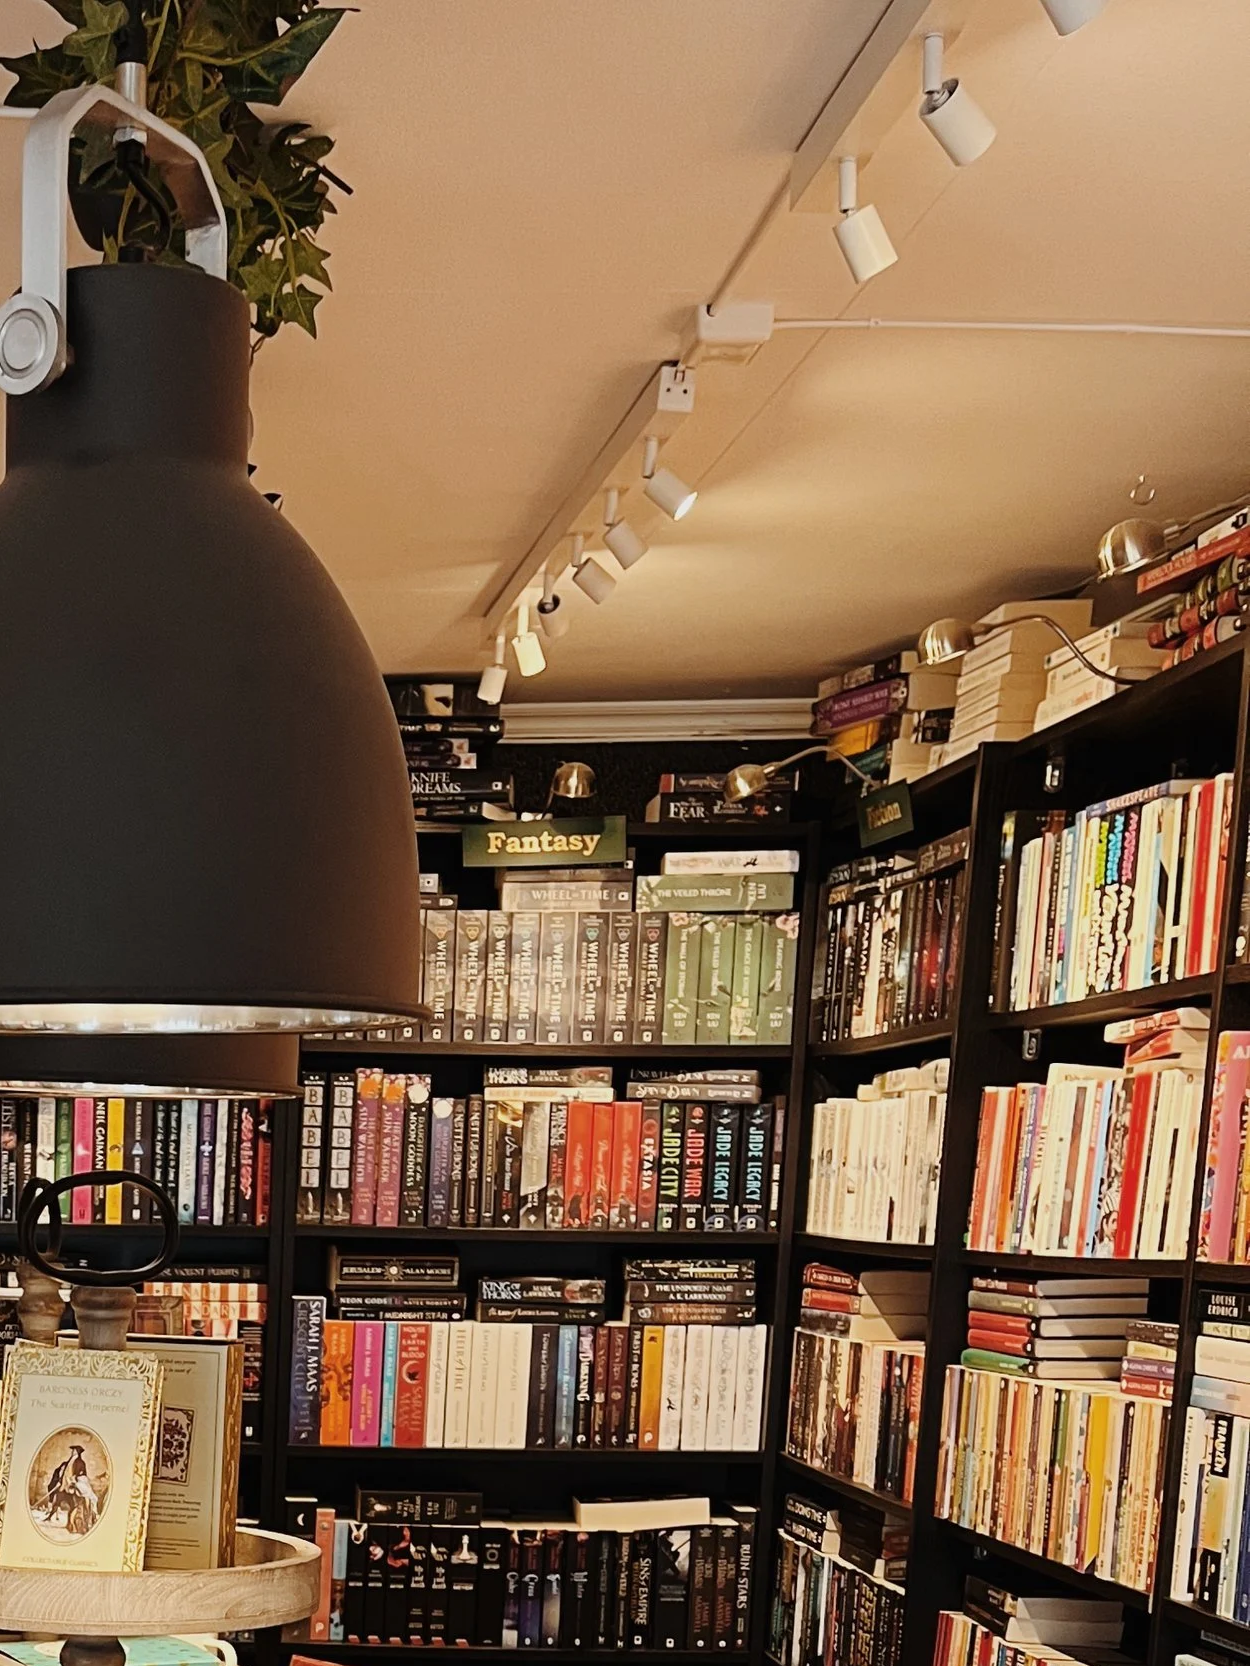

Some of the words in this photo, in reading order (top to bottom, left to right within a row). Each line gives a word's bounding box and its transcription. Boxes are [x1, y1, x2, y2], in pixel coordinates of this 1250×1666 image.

[411, 772, 450, 783] KNIFE
[487, 831, 600, 856] Fantasy
[581, 889, 609, 901] TIME
[435, 940, 447, 984] WHEEL
[467, 940, 479, 984] WHEEL
[494, 940, 506, 983] WHEEL
[520, 940, 532, 984] WHEEL
[552, 943, 564, 987] WHEEL
[587, 942, 599, 987] WHEEL
[617, 942, 630, 986] WHEEL
[647, 942, 659, 987] WHEEL
[434, 992, 445, 1020] TIME
[465, 992, 477, 1021] TIME
[492, 992, 504, 1021] TIME
[518, 992, 530, 1021] TIME
[549, 993, 562, 1023] TIME
[584, 991, 597, 1022] TIME
[615, 993, 627, 1022] TIME
[645, 994, 656, 1022] TIME
[95, 1101, 105, 1119] NEIL
[661, 1129, 682, 1165] JADE
[685, 1129, 705, 1166] JADE
[715, 1127, 732, 1157] JADE
[748, 1127, 764, 1157] JADE
[660, 1167, 678, 1198] CITY
[684, 1168, 703, 1198] WAR
[712, 1161, 730, 1201] LEGACY
[745, 1161, 762, 1201] LEGACY
[339, 1297, 363, 1305] NEON
[364, 1297, 388, 1305] GODS
[1207, 1303, 1239, 1319] ERDRICH
[1211, 1292, 1237, 1307] LOUISE
[308, 1301, 321, 1343] SARAH
[425, 1312, 448, 1320] STAR
[305, 1355, 318, 1392] MAAS
[30, 1399, 47, 1409] The
[1214, 1420, 1229, 1474] FRANZEN
[740, 1543, 751, 1571] RUIN
[736, 1577, 749, 1609] STARS
